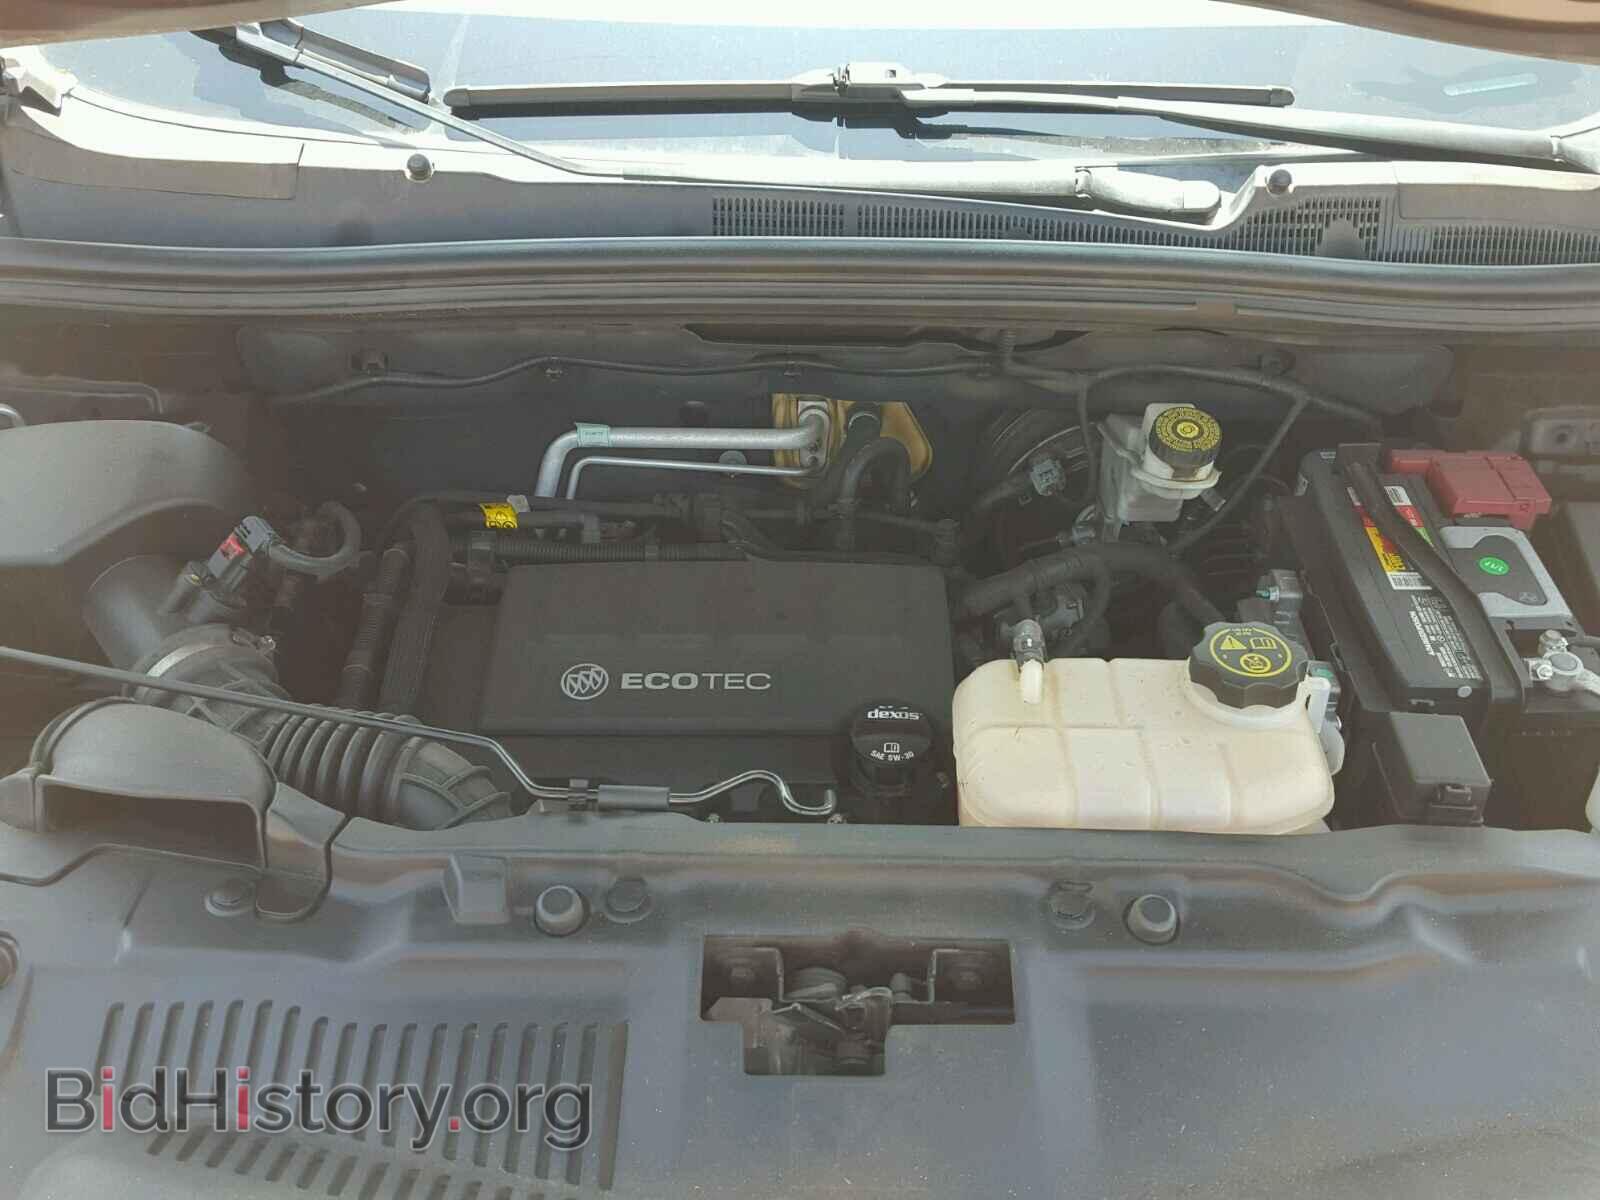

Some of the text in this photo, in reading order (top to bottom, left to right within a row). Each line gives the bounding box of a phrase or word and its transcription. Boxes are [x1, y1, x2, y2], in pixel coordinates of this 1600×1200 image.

[621, 672, 771, 690] ECOTEC
[867, 708, 920, 720] dexos
[870, 749, 885, 761] SAE
